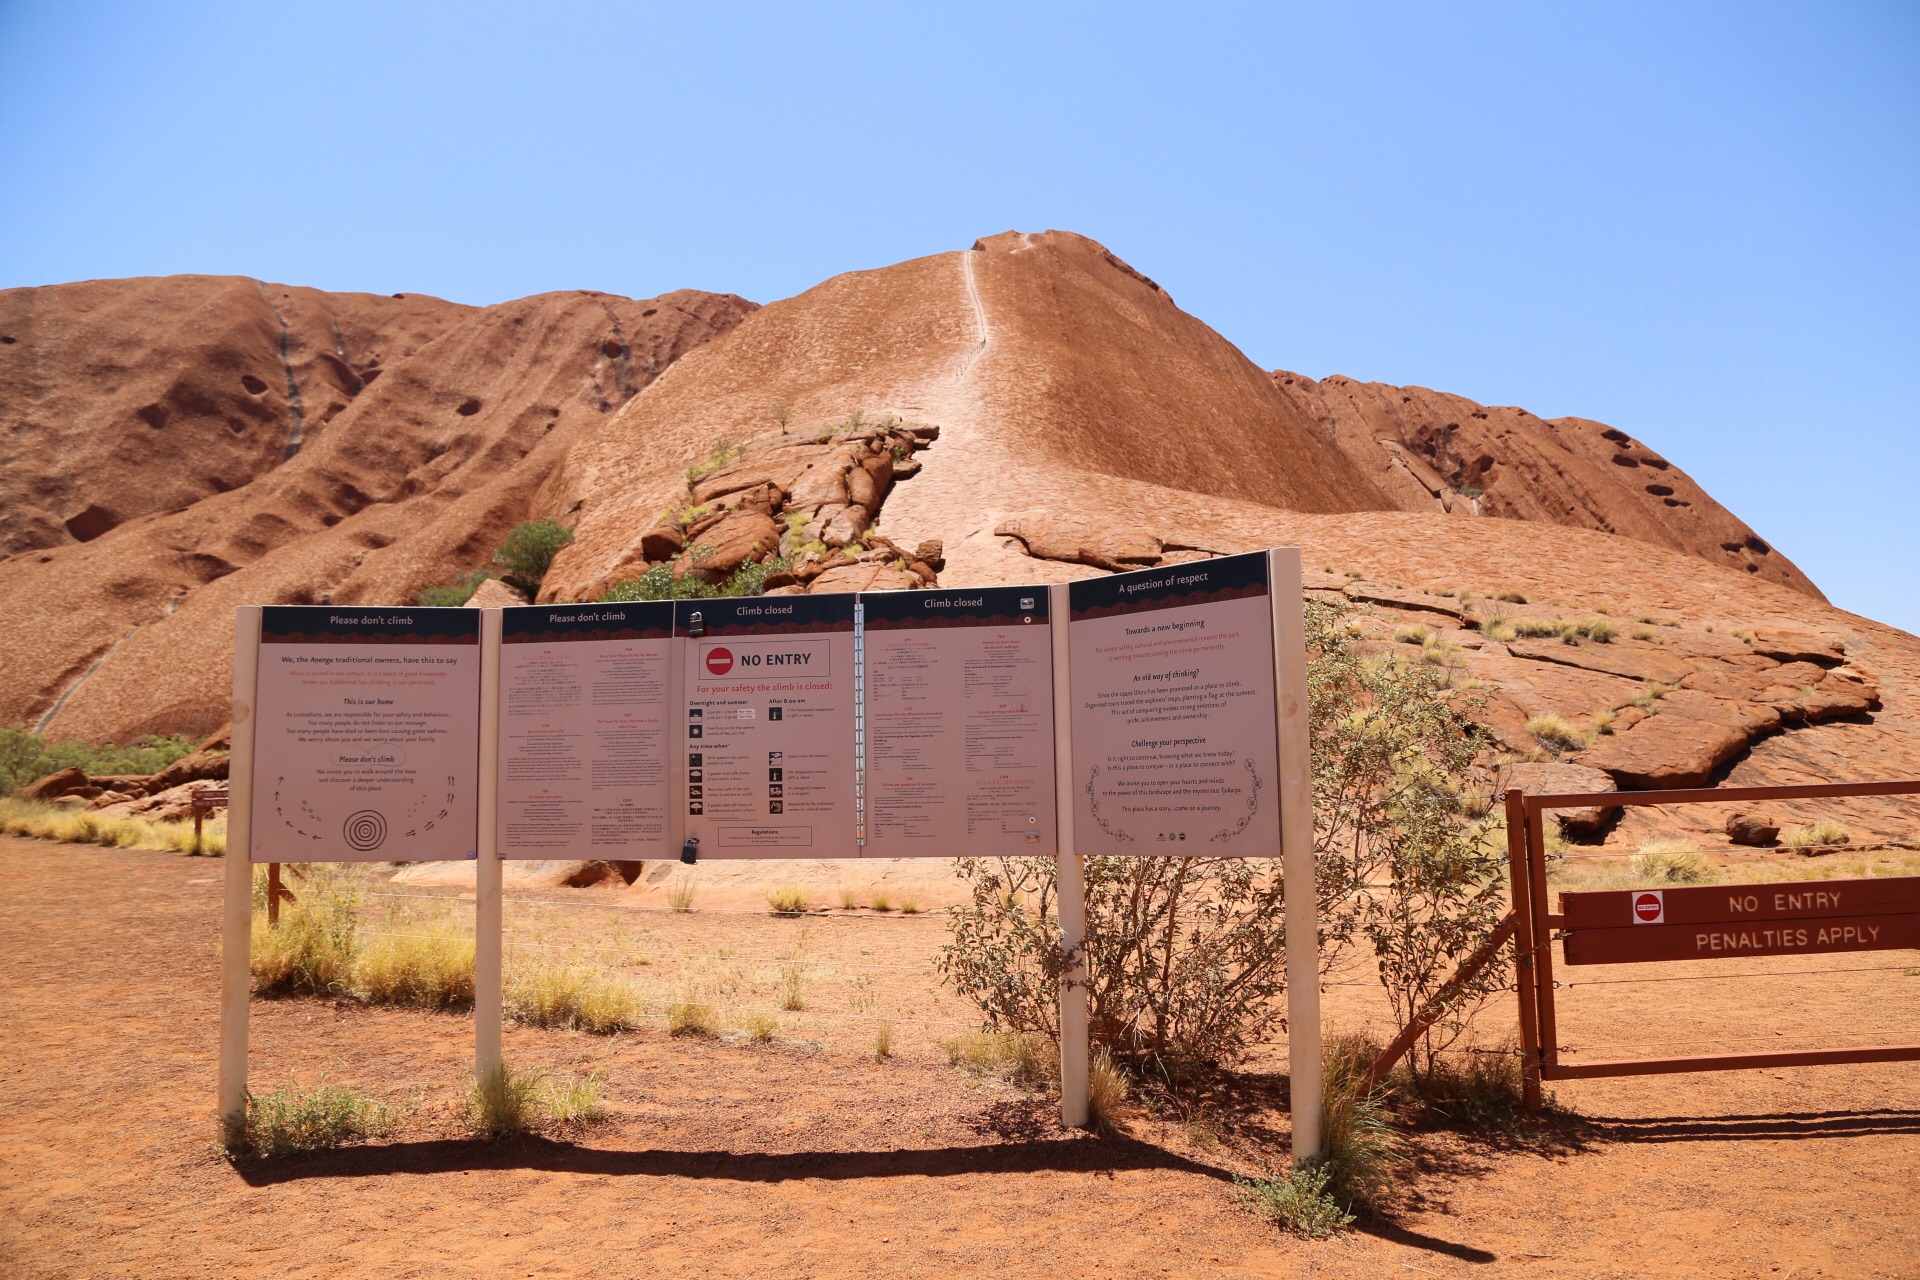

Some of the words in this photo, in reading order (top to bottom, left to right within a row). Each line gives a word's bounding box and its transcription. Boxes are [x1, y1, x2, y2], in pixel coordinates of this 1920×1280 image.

[1118, 584, 1125, 593] A
[1126, 579, 1163, 595] question
[1165, 575, 1175, 586] of
[1177, 573, 1208, 586] respect
[924, 598, 951, 608] Climb
[953, 596, 983, 607] closed
[736, 606, 762, 616] Climb
[764, 604, 793, 615] closed
[330, 615, 359, 625] Please
[360, 615, 385, 625] don't
[387, 616, 413, 625] climb
[549, 614, 576, 623] Please
[577, 612, 600, 622] don't
[601, 611, 626, 621] climb
[1125, 625, 1150, 635] Towards
[1172, 619, 1205, 632] beginning
[281, 656, 295, 664] We,
[403, 656, 420, 664] have
[421, 656, 435, 664] this
[445, 658, 458, 666] say
[741, 654, 761, 666] NO
[766, 653, 811, 666] ENTRY
[1142, 673, 1151, 681] old
[1152, 674, 1164, 682] way
[1164, 670, 1172, 682] of
[1172, 668, 1200, 679] thinking?
[697, 685, 709, 693] For
[711, 686, 730, 695] your
[731, 683, 756, 694] safety
[757, 683, 771, 691] the
[772, 682, 795, 691] climb
[796, 682, 803, 691] is
[805, 681, 833, 690] closed:
[395, 711, 411, 719] safety
[389, 736, 404, 744] about
[1131, 739, 1158, 749] Challenge
[1159, 740, 1172, 748] your
[1173, 736, 1206, 748] perspective
[339, 755, 359, 763] Please
[359, 755, 376, 763] don't
[377, 755, 395, 763] climb
[1148, 788, 1171, 796] landscape
[1132, 805, 1144, 813] place
[1200, 804, 1222, 812] journey.
[1729, 895, 1758, 913] NO
[1774, 892, 1840, 911] ENTRY
[1696, 929, 1808, 950] PENALTIES
[1817, 926, 1879, 944] APPLY
